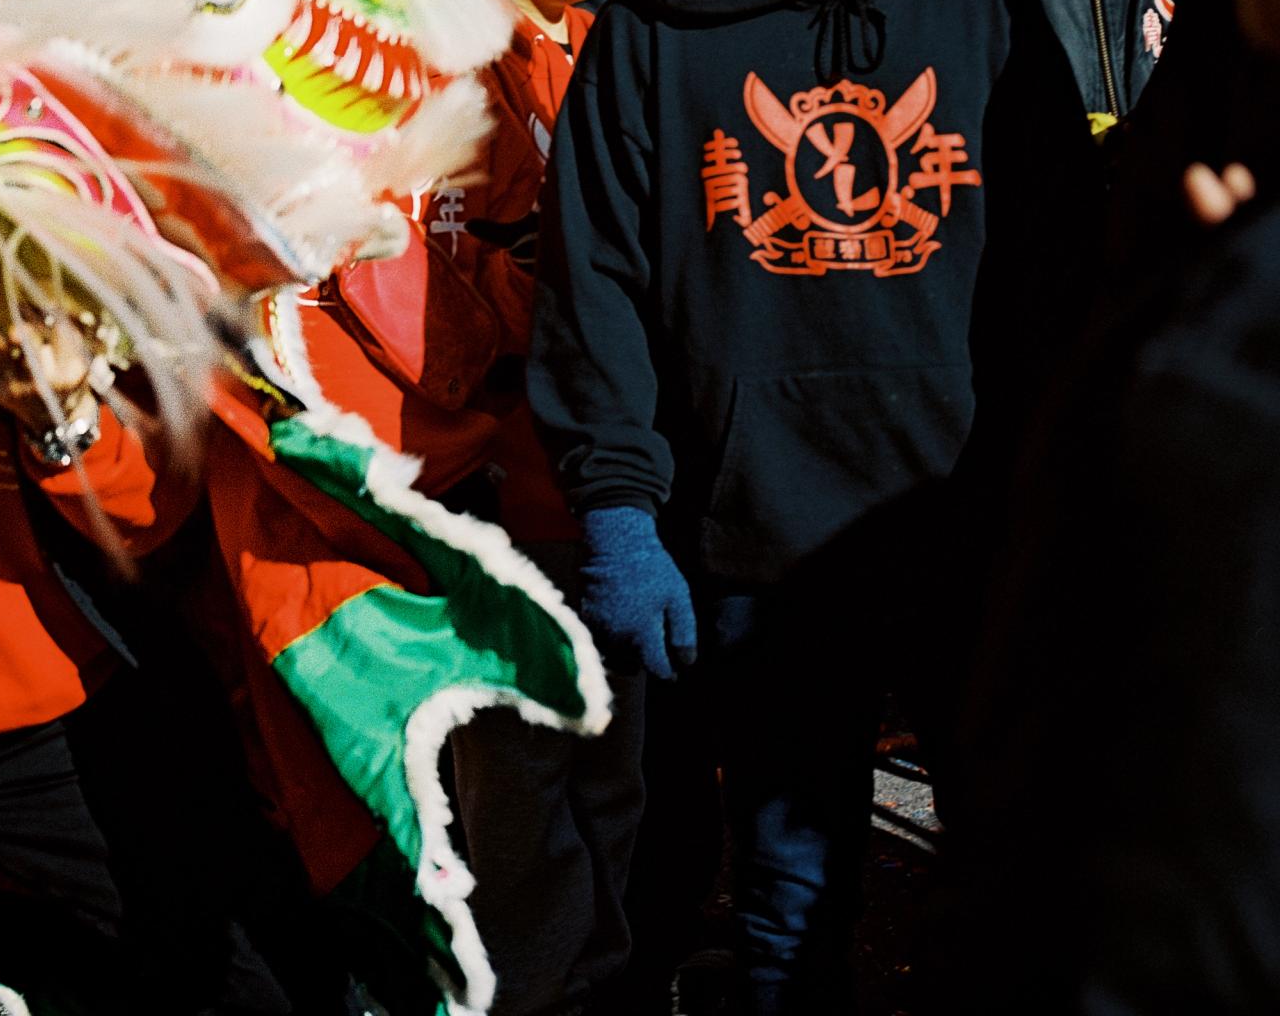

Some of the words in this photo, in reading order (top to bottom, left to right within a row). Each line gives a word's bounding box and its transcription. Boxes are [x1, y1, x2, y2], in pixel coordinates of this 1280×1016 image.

[429, 174, 468, 261] 年
[700, 128, 753, 231] 青
[908, 122, 983, 217] 年
